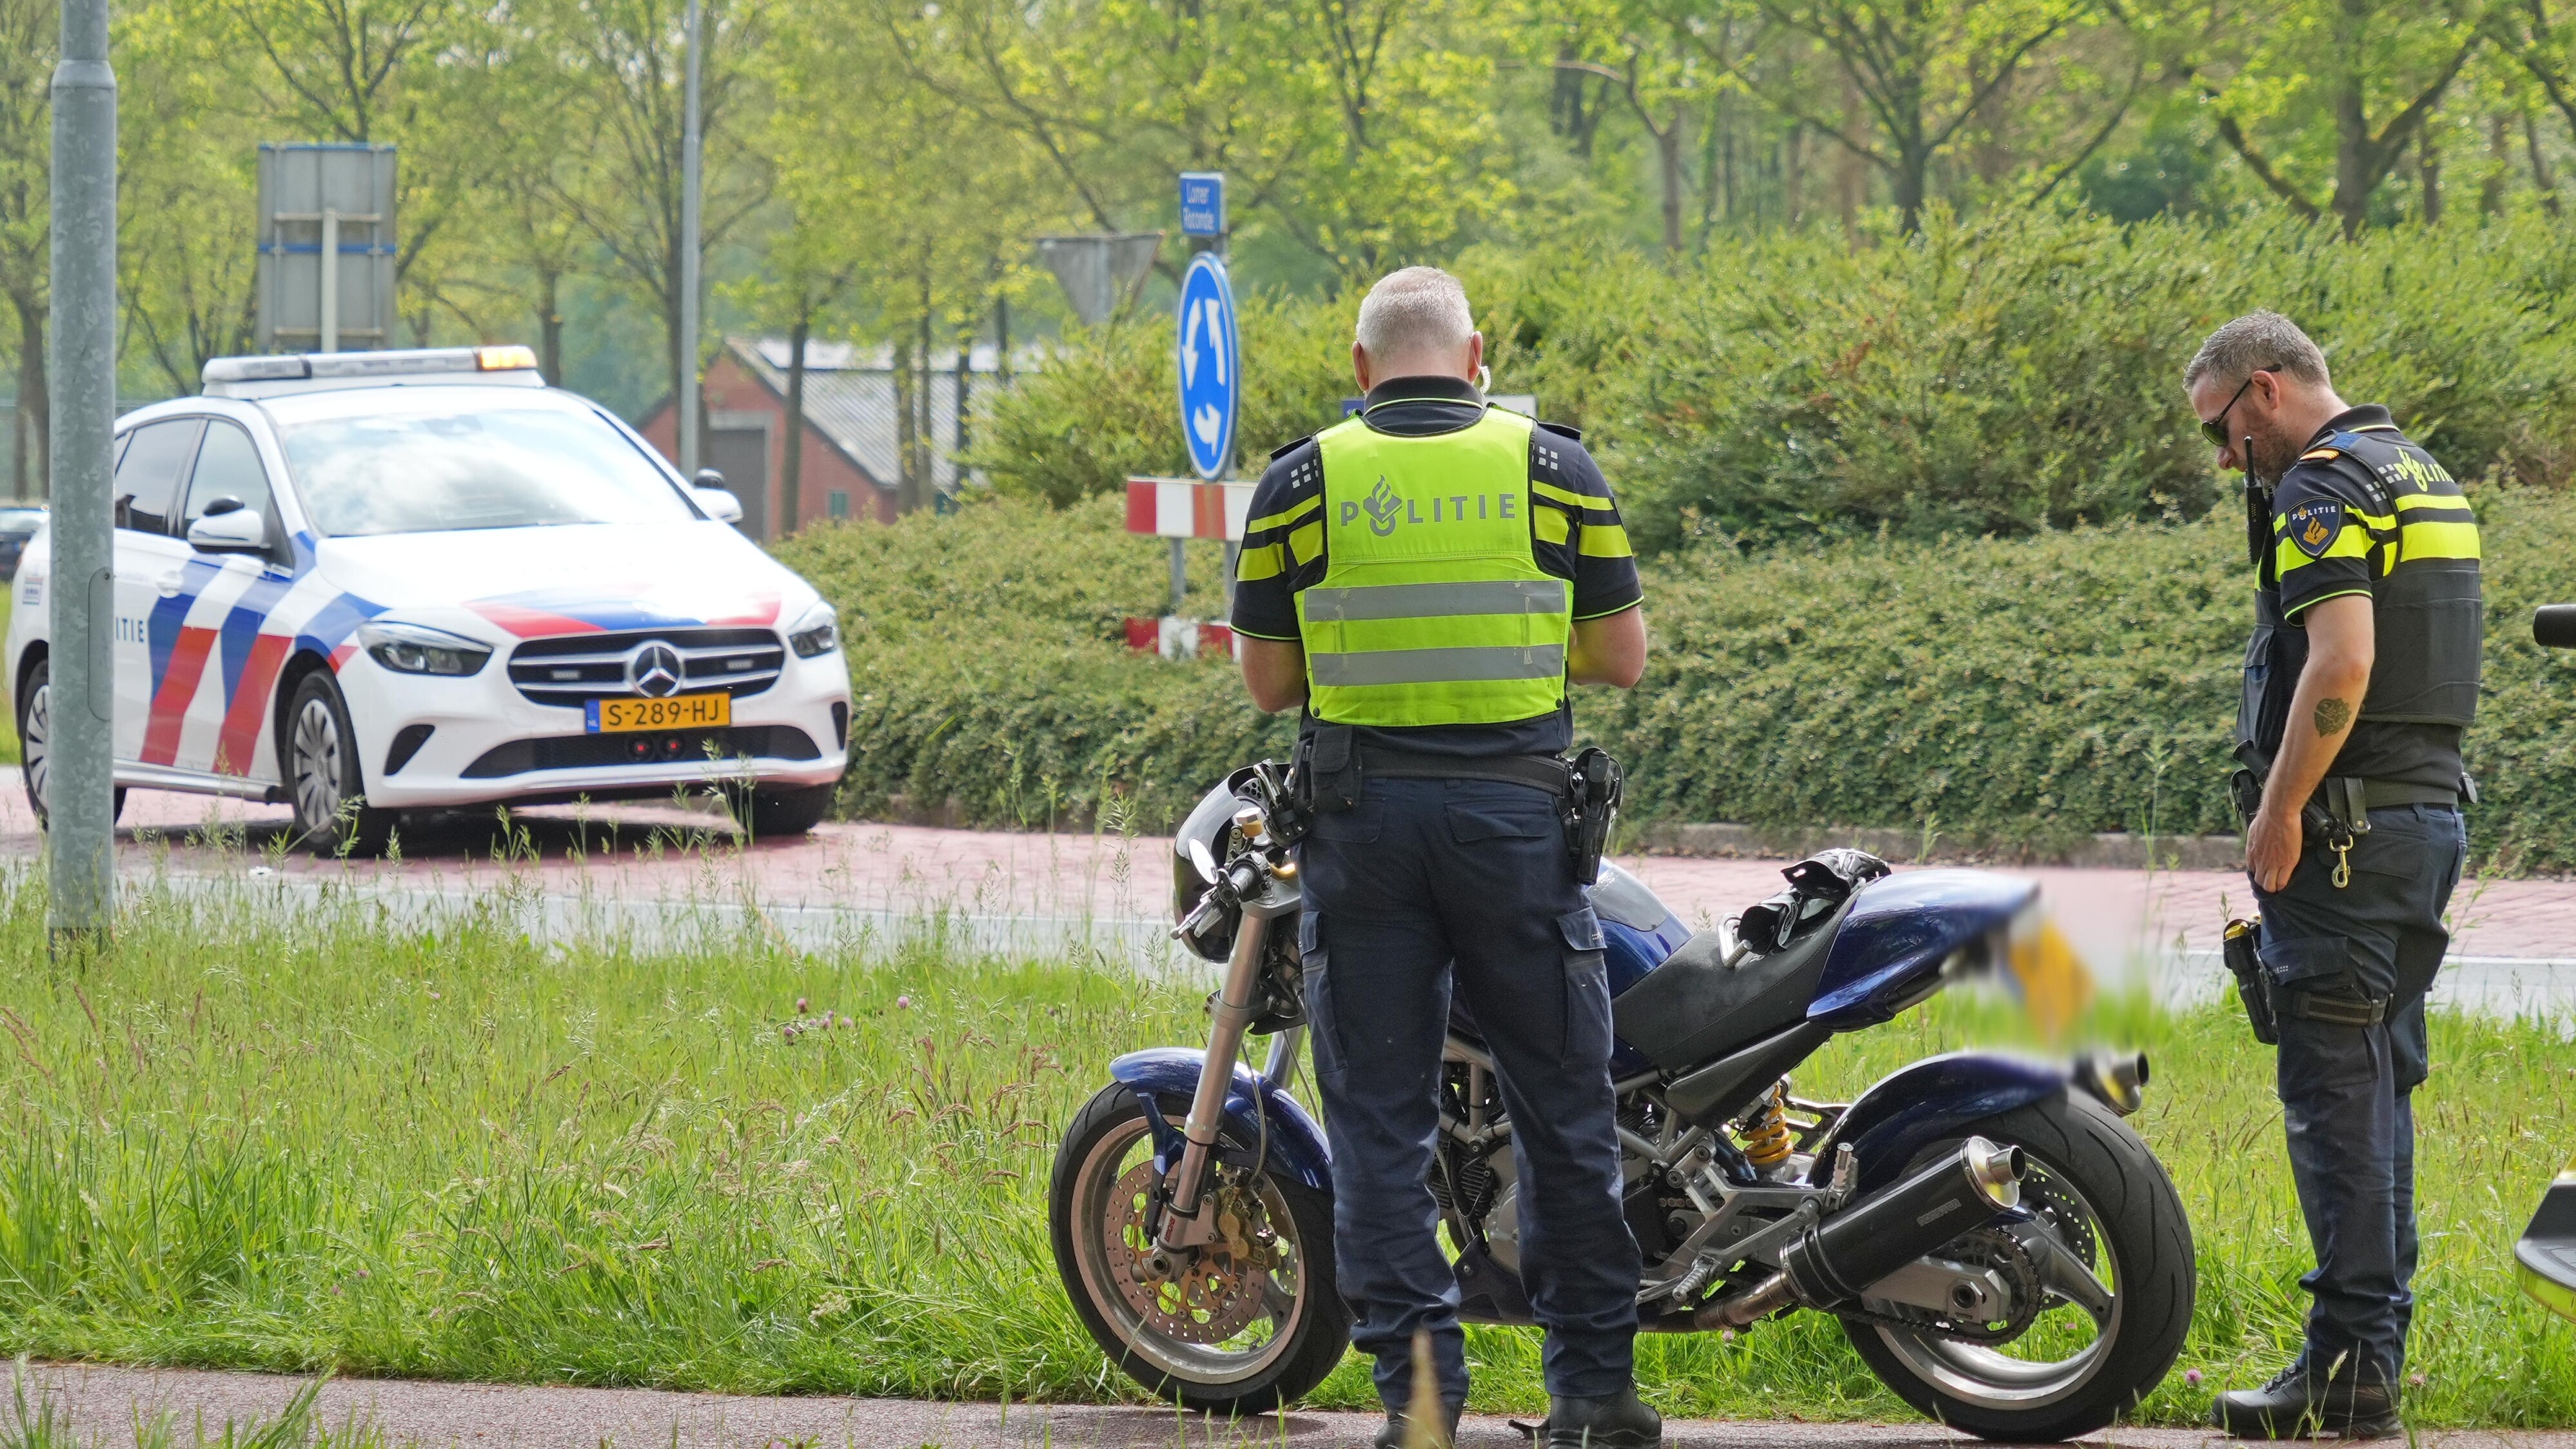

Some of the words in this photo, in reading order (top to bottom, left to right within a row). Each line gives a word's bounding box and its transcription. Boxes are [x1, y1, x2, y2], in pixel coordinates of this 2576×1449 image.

[2393, 463, 2455, 492] POLITI
[1341, 493, 1516, 537] POLITIE
[115, 616, 144, 643] ITIE
[607, 699, 720, 726] S-289-HJ
